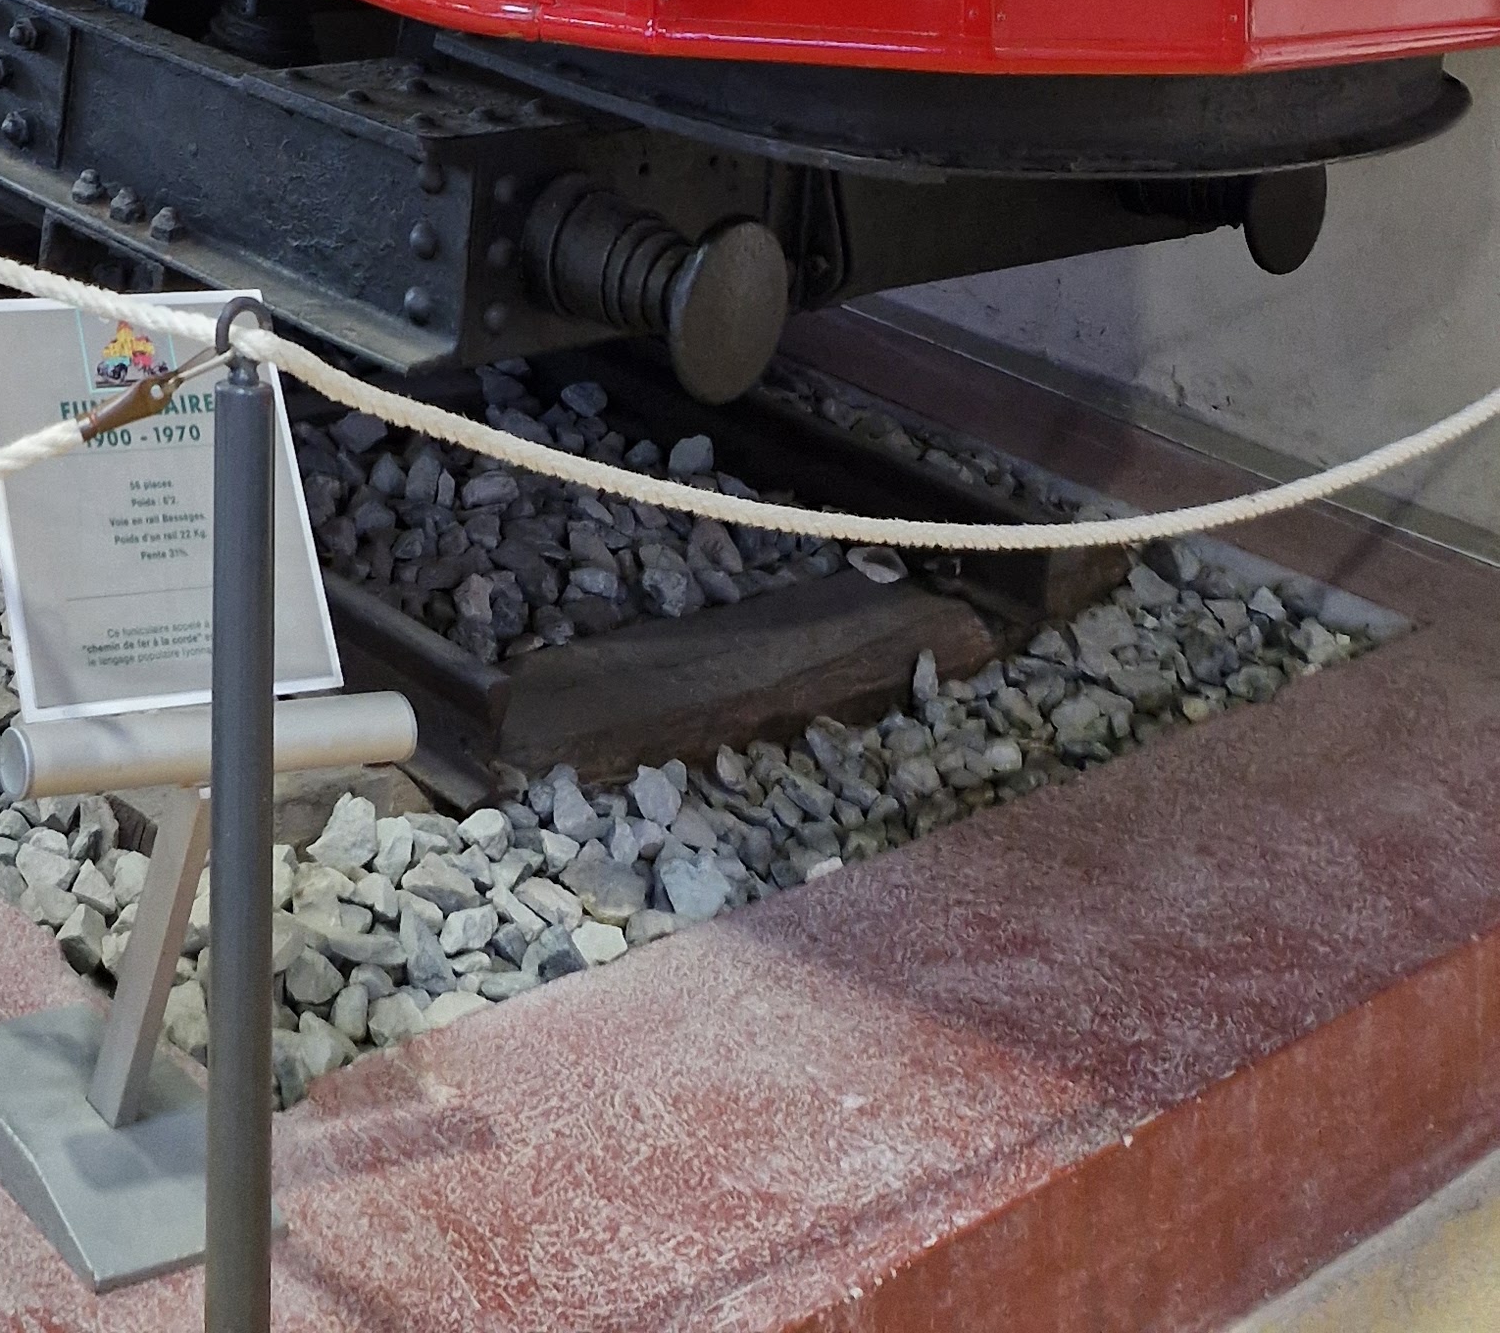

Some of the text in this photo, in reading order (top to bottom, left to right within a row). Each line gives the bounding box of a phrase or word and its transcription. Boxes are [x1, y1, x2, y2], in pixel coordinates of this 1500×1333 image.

[60, 393, 214, 420] FUAIRE
[153, 424, 201, 444] 1970
[123, 640, 134, 650] de
